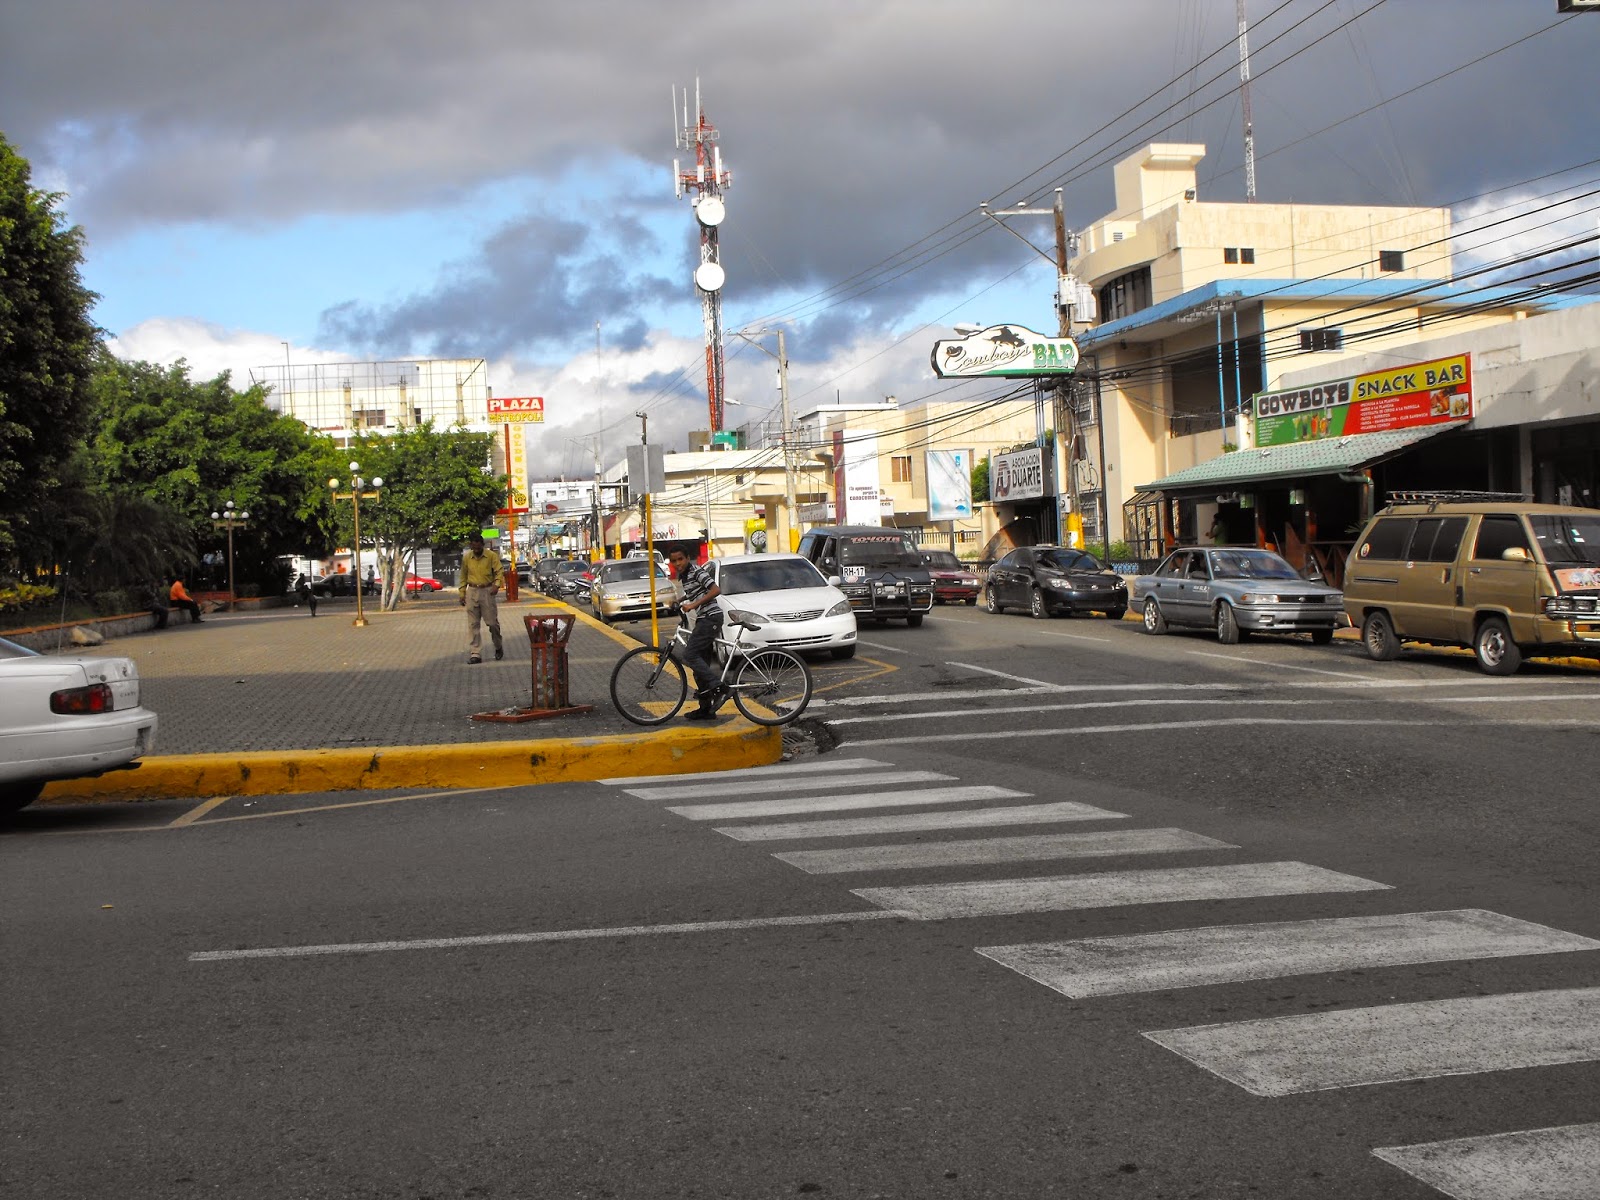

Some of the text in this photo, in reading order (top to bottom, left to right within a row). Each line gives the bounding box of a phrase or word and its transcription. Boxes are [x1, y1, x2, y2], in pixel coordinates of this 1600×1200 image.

[1032, 343, 1075, 369] BAR
[1258, 364, 1465, 416] COWBOYS SNACK BAR
[489, 399, 541, 411] PLAZA
[1012, 465, 1041, 488] DUARTE
[844, 567, 863, 576] RH-17
